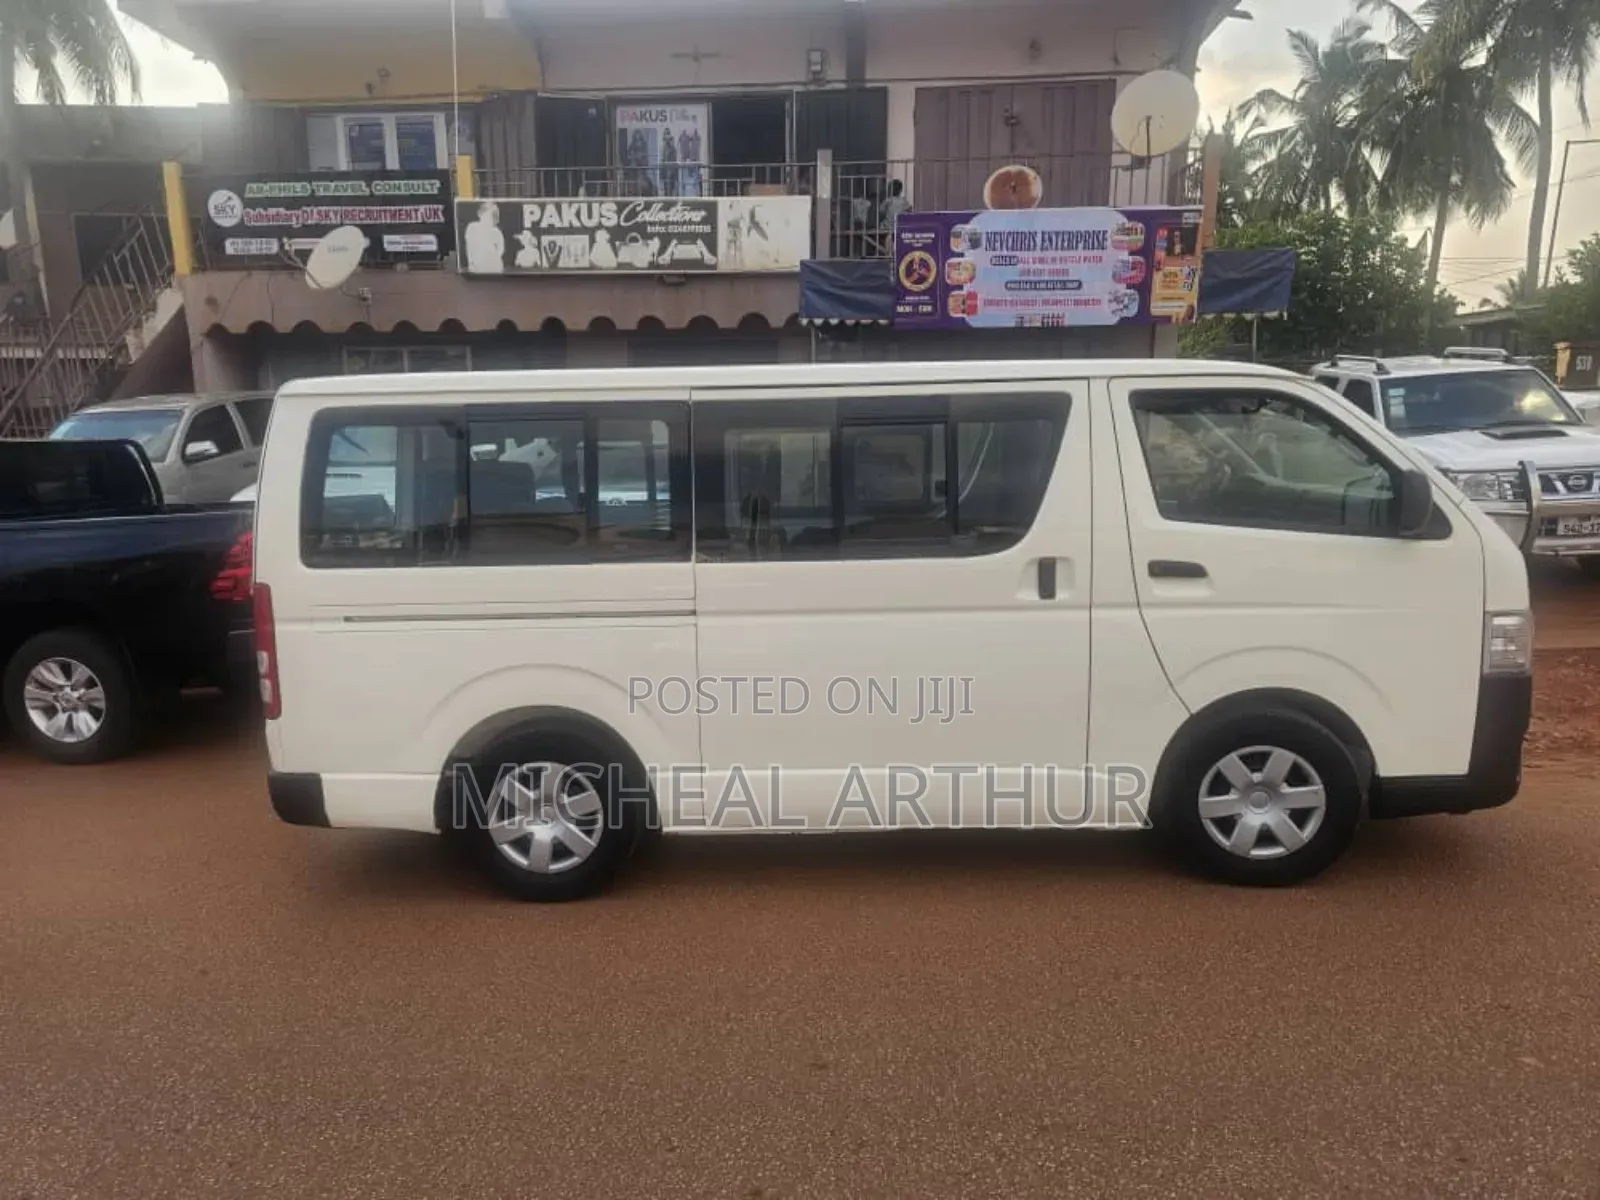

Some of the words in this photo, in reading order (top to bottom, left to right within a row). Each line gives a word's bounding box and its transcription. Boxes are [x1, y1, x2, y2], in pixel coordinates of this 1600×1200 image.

[312, 181, 369, 196] TRAVEL
[371, 180, 440, 195] CONSULT
[341, 205, 421, 224] RECRUITMENT
[421, 204, 444, 223] UK
[522, 202, 618, 228] PAKUS
[1040, 230, 1108, 251] ENTERPRISE
